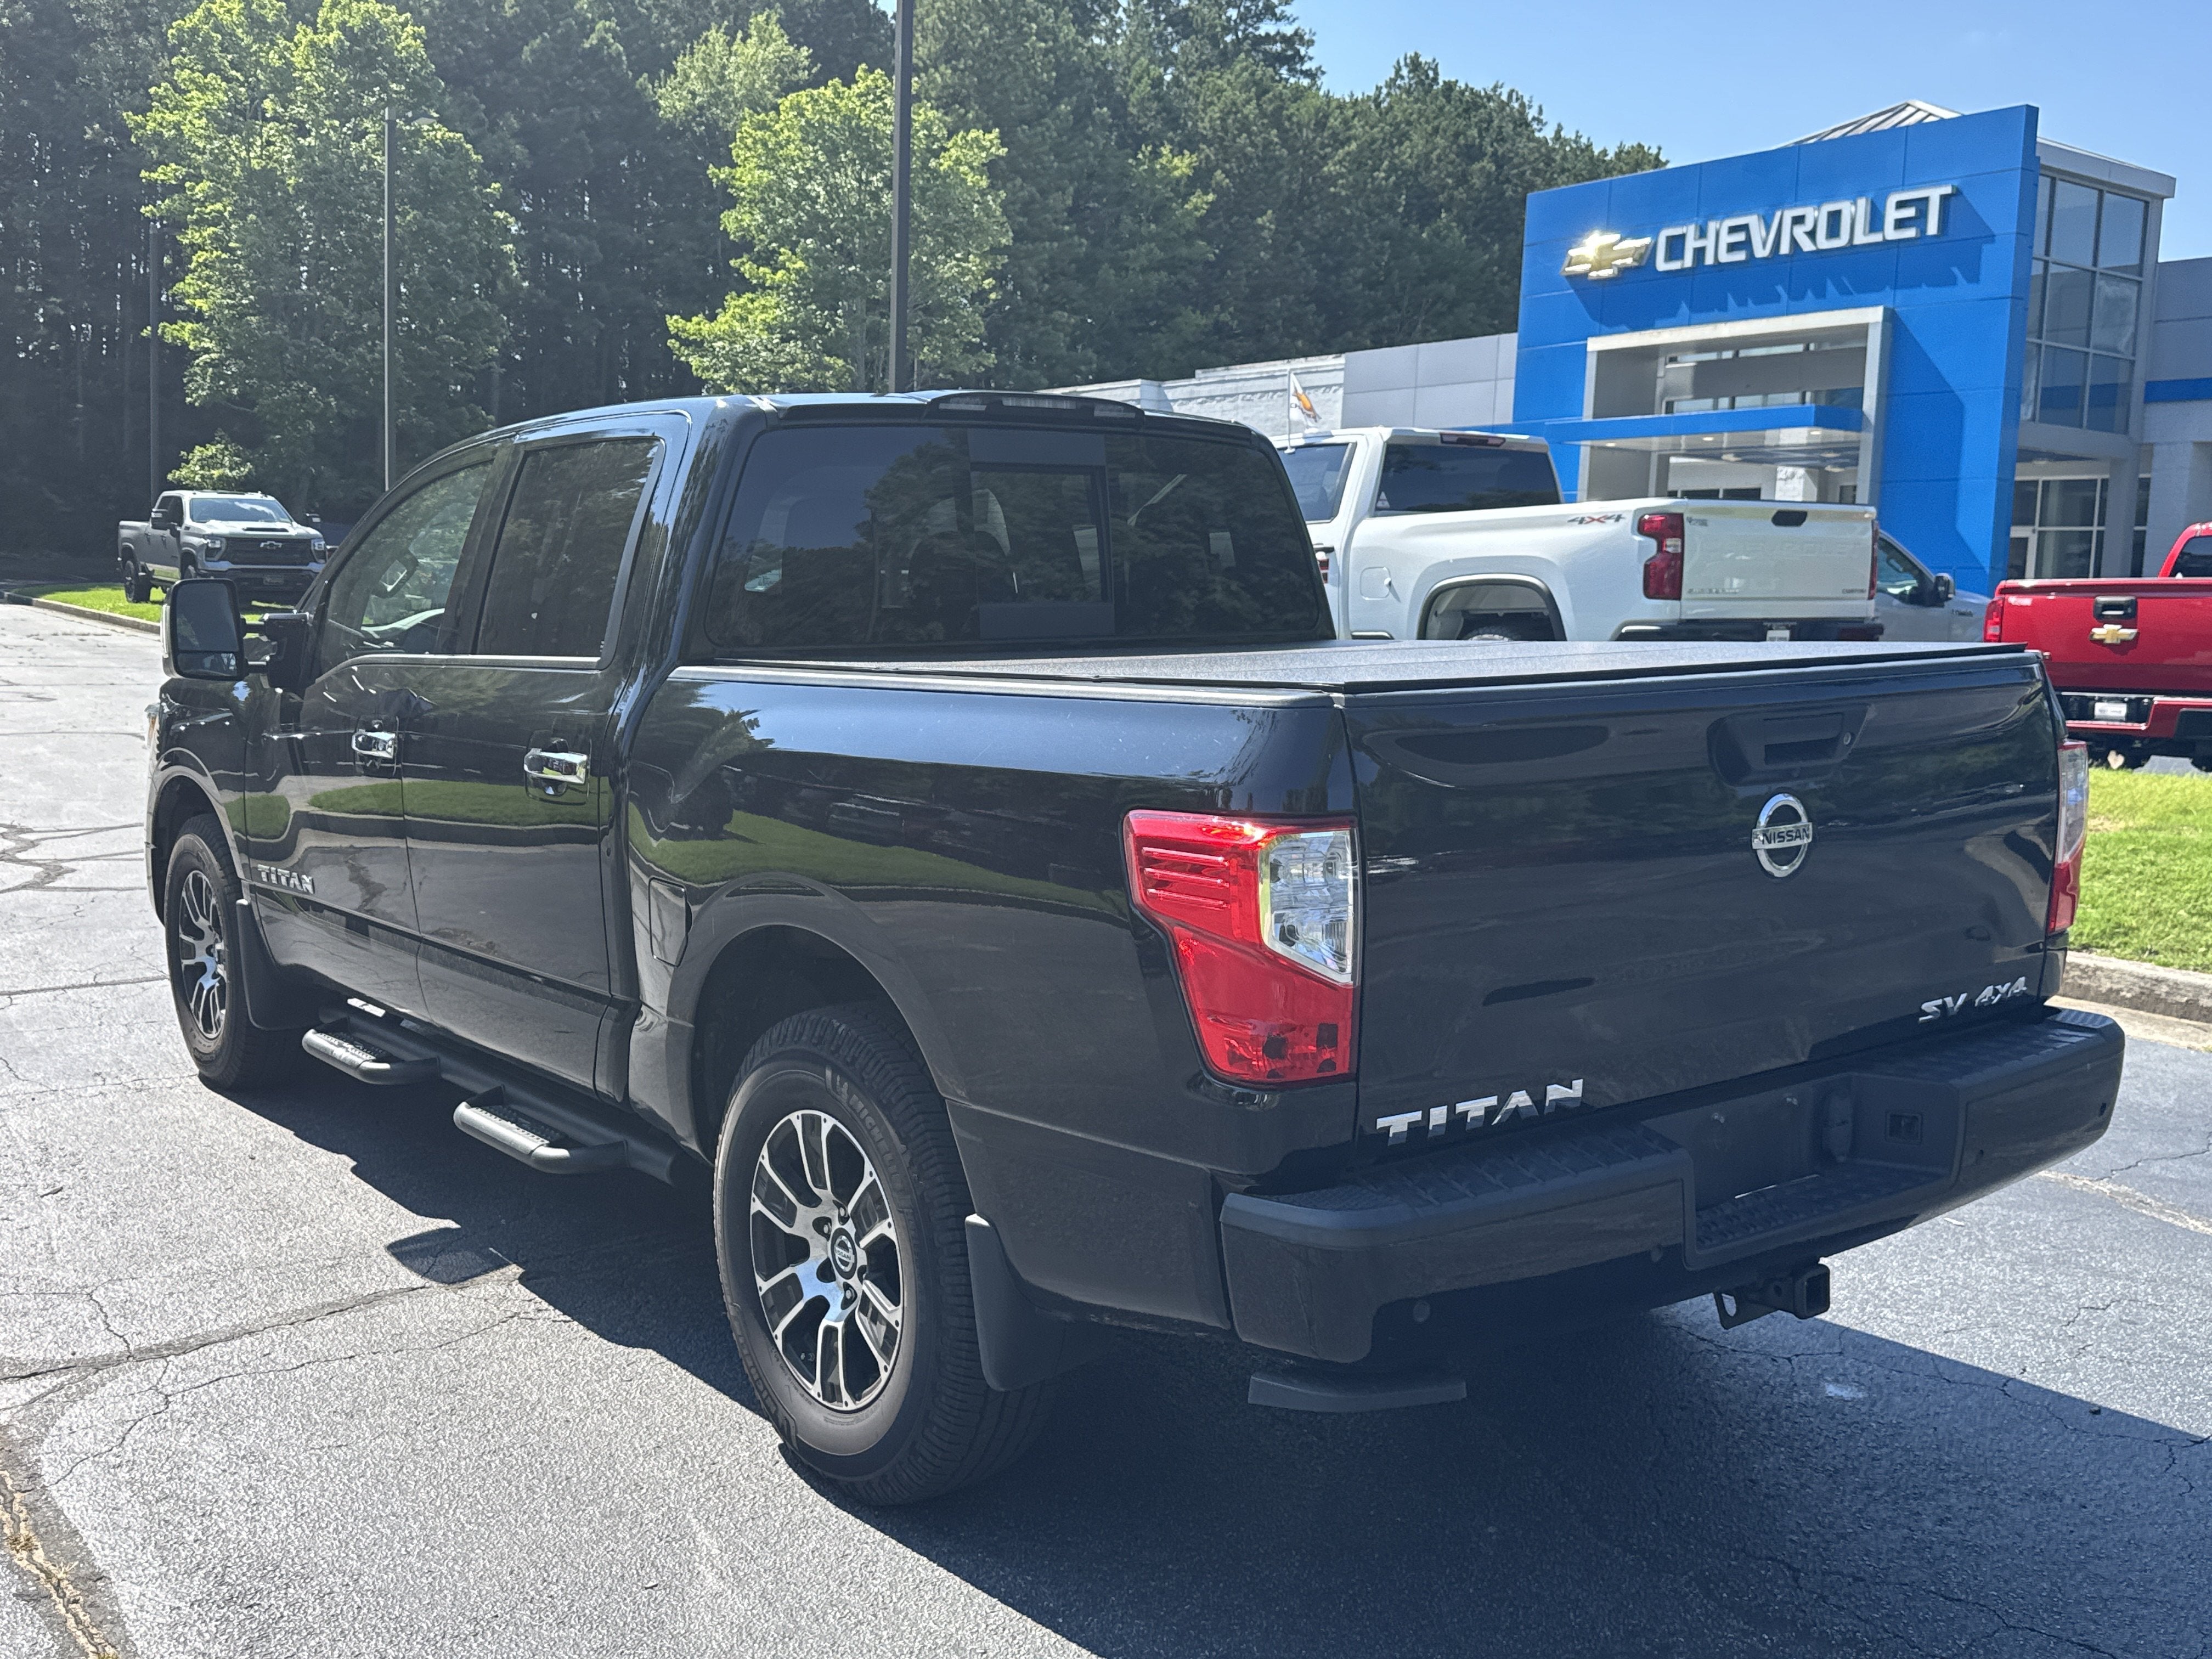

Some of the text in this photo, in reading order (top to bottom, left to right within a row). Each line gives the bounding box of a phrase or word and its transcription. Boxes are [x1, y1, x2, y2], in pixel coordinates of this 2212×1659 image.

[1656, 184, 1954, 272] CHEVROLET
[1762, 828, 1809, 845] NISSAN
[258, 864, 315, 894] TITAN
[1919, 992, 1968, 1023] SV
[1376, 1079, 1583, 1147] TITAN
